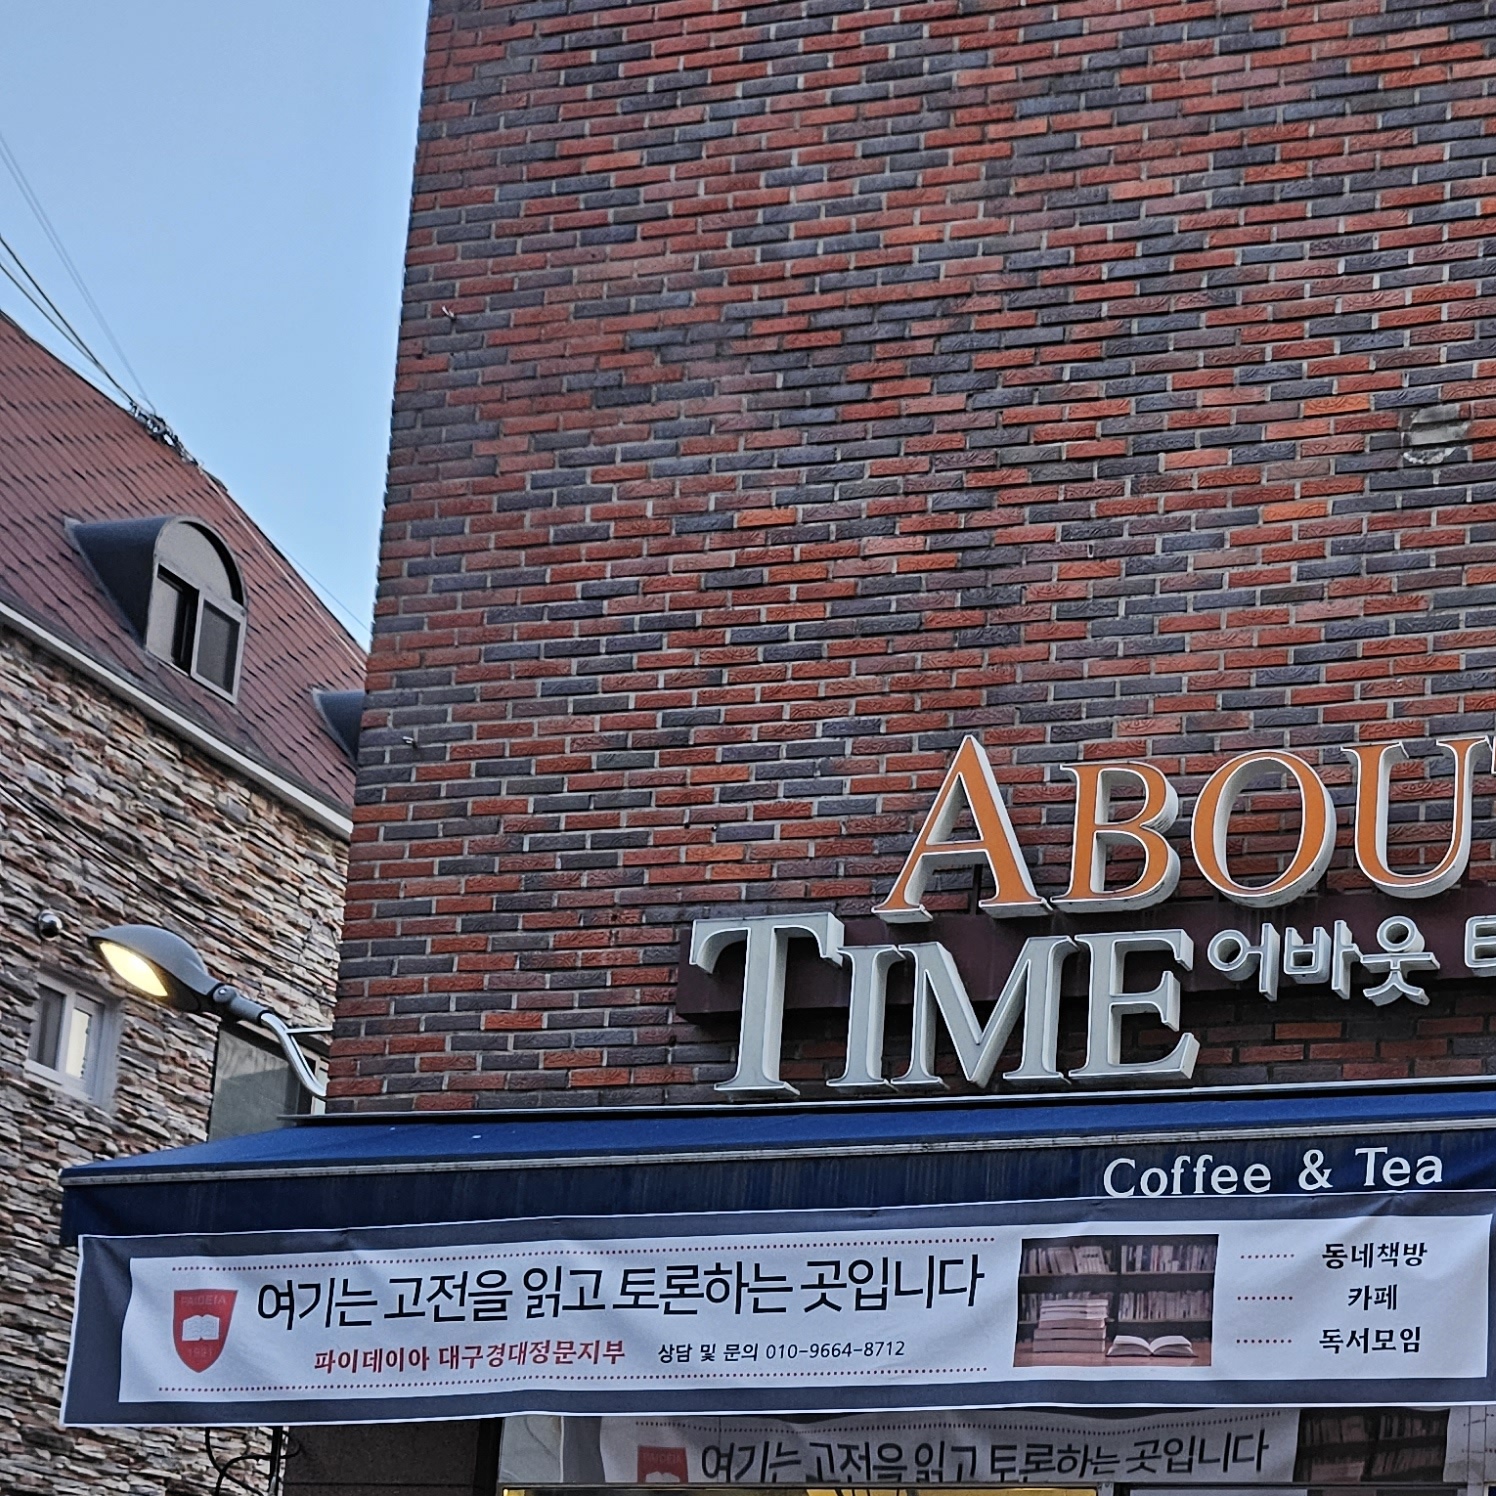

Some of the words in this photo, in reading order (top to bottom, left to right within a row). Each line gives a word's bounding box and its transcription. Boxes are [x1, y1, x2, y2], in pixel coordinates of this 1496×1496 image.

[1206, 915, 1441, 1006] 어바웃
[689, 909, 1201, 1100] TIME
[1103, 1154, 1273, 1198] Coffee
[1298, 1148, 1332, 1190] &
[1354, 1145, 1444, 1187] Tea
[1321, 1240, 1429, 1270] 동네책방
[256, 1275, 381, 1331] 여기는
[383, 1269, 514, 1324] 고전을
[521, 1265, 608, 1320] 읽고
[613, 1258, 796, 1316] 토론하는
[801, 1253, 986, 1314] 곳입니다
[1347, 1284, 1399, 1312] 카페
[313, 1342, 431, 1375] 파이데이아
[438, 1338, 626, 1370] 대구경대정문지부
[657, 1341, 694, 1364] 상담
[699, 1340, 718, 1364] 및
[722, 1340, 759, 1363] 문의
[765, 1338, 906, 1361] 010-9664-8712
[1318, 1326, 1423, 1355] 독서모임
[700, 1440, 801, 1483] 여기는
[806, 1441, 906, 1483] 고전을
[1124, 1430, 1271, 1477] 곳입니다
